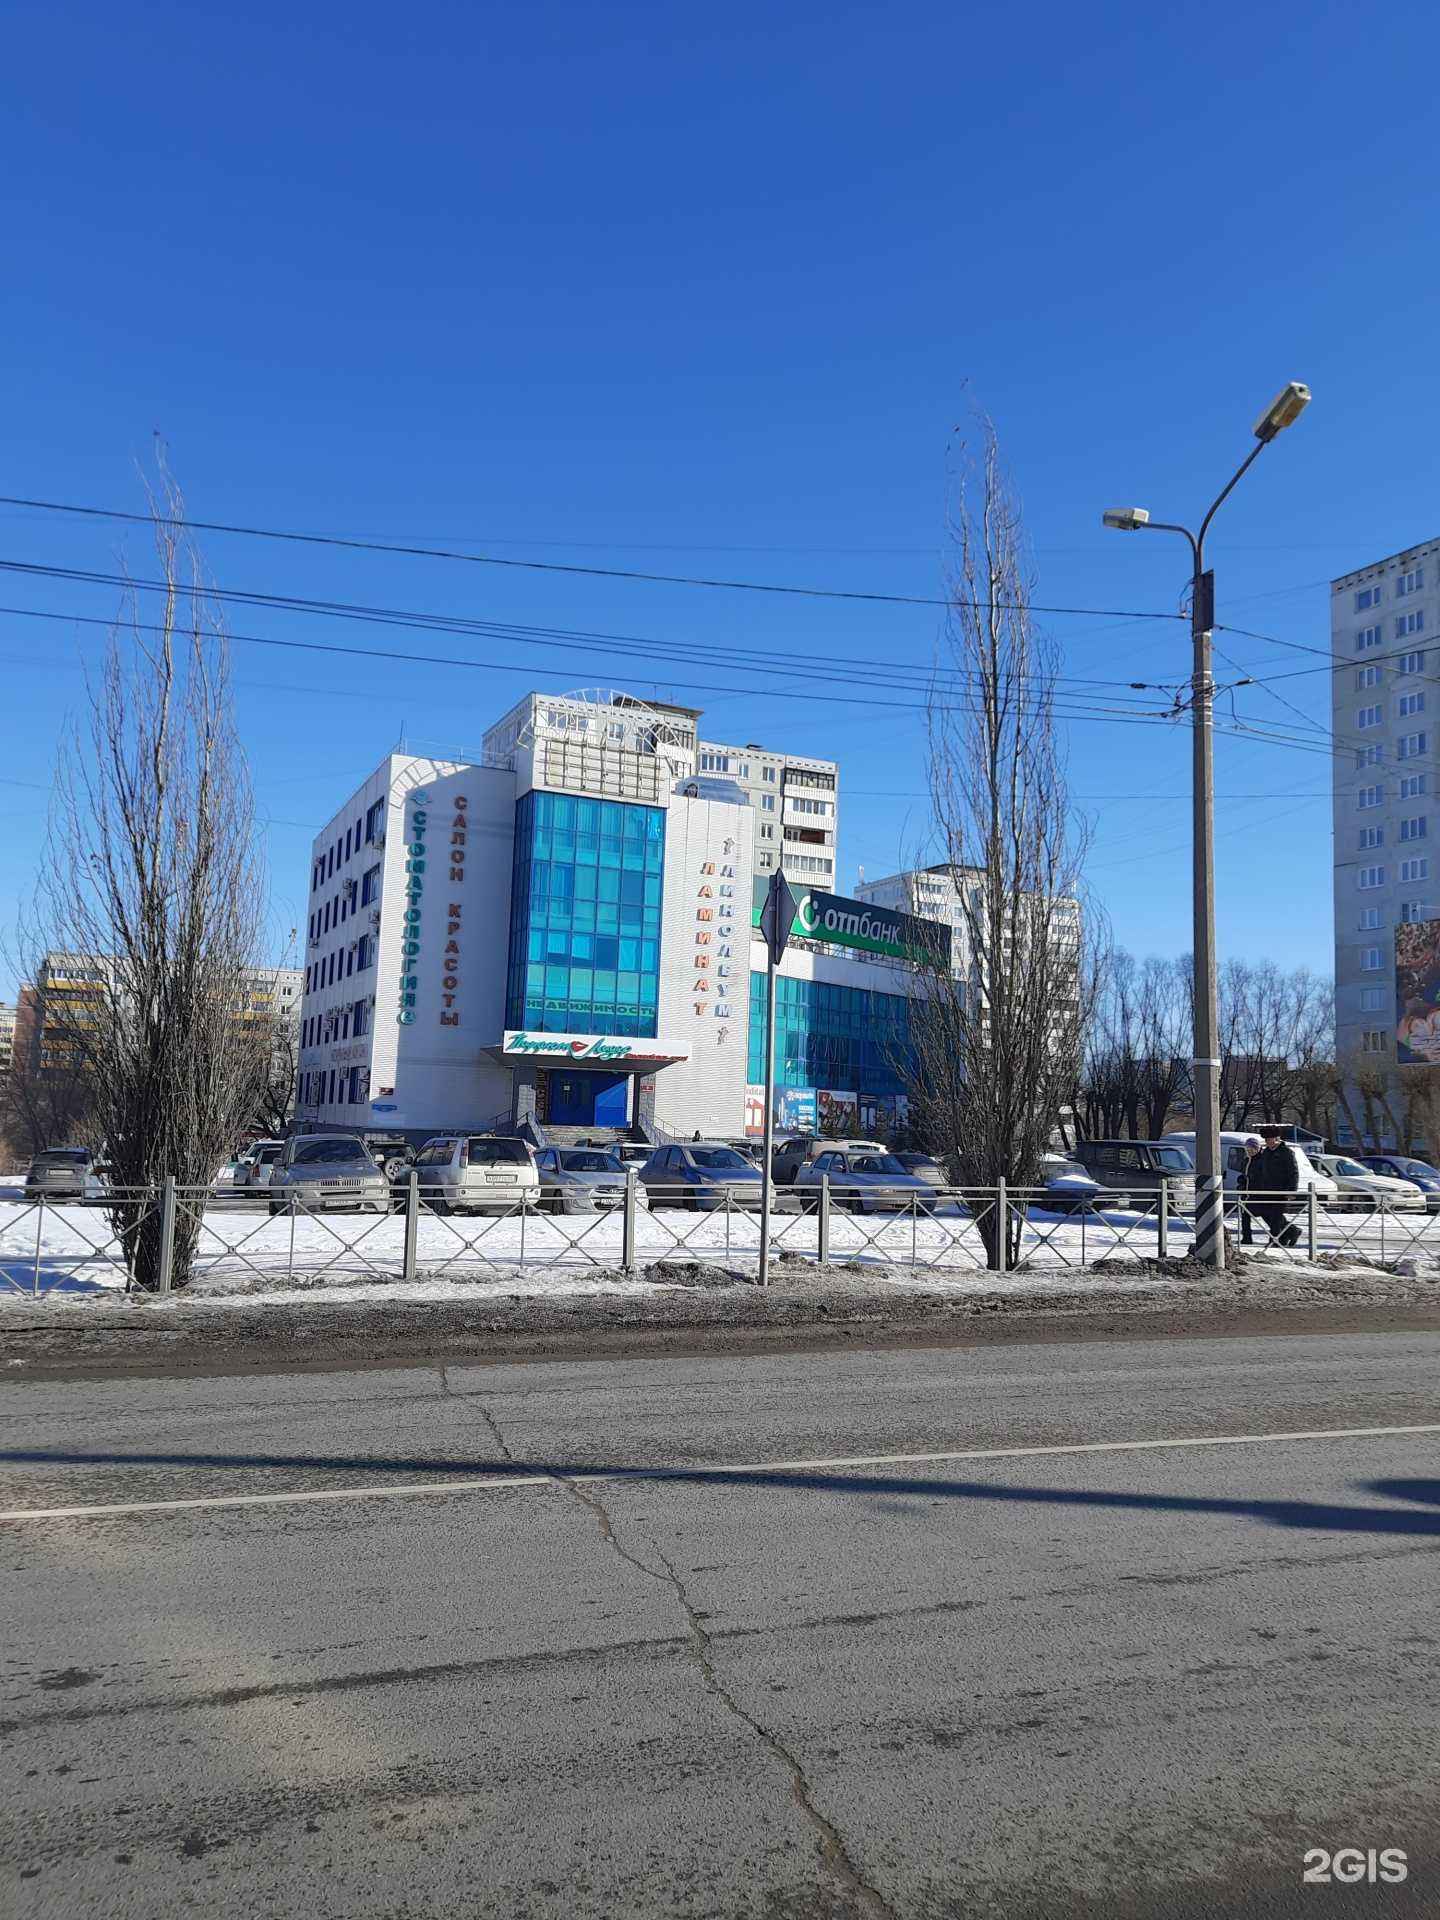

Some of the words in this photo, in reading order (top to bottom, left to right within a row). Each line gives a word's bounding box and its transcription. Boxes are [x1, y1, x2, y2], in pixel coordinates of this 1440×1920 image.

[450, 796, 468, 882] САЛОН
[399, 811, 427, 1010] СТОМАТОЛОГИЯ
[440, 903, 461, 1026] КРАСОТЫ
[693, 862, 716, 1016] ЛАМИНАТ
[714, 864, 736, 1017] ЛИНОЛЕУМ
[526, 999, 655, 1017] НЕДВИЖИМОСТЬ
